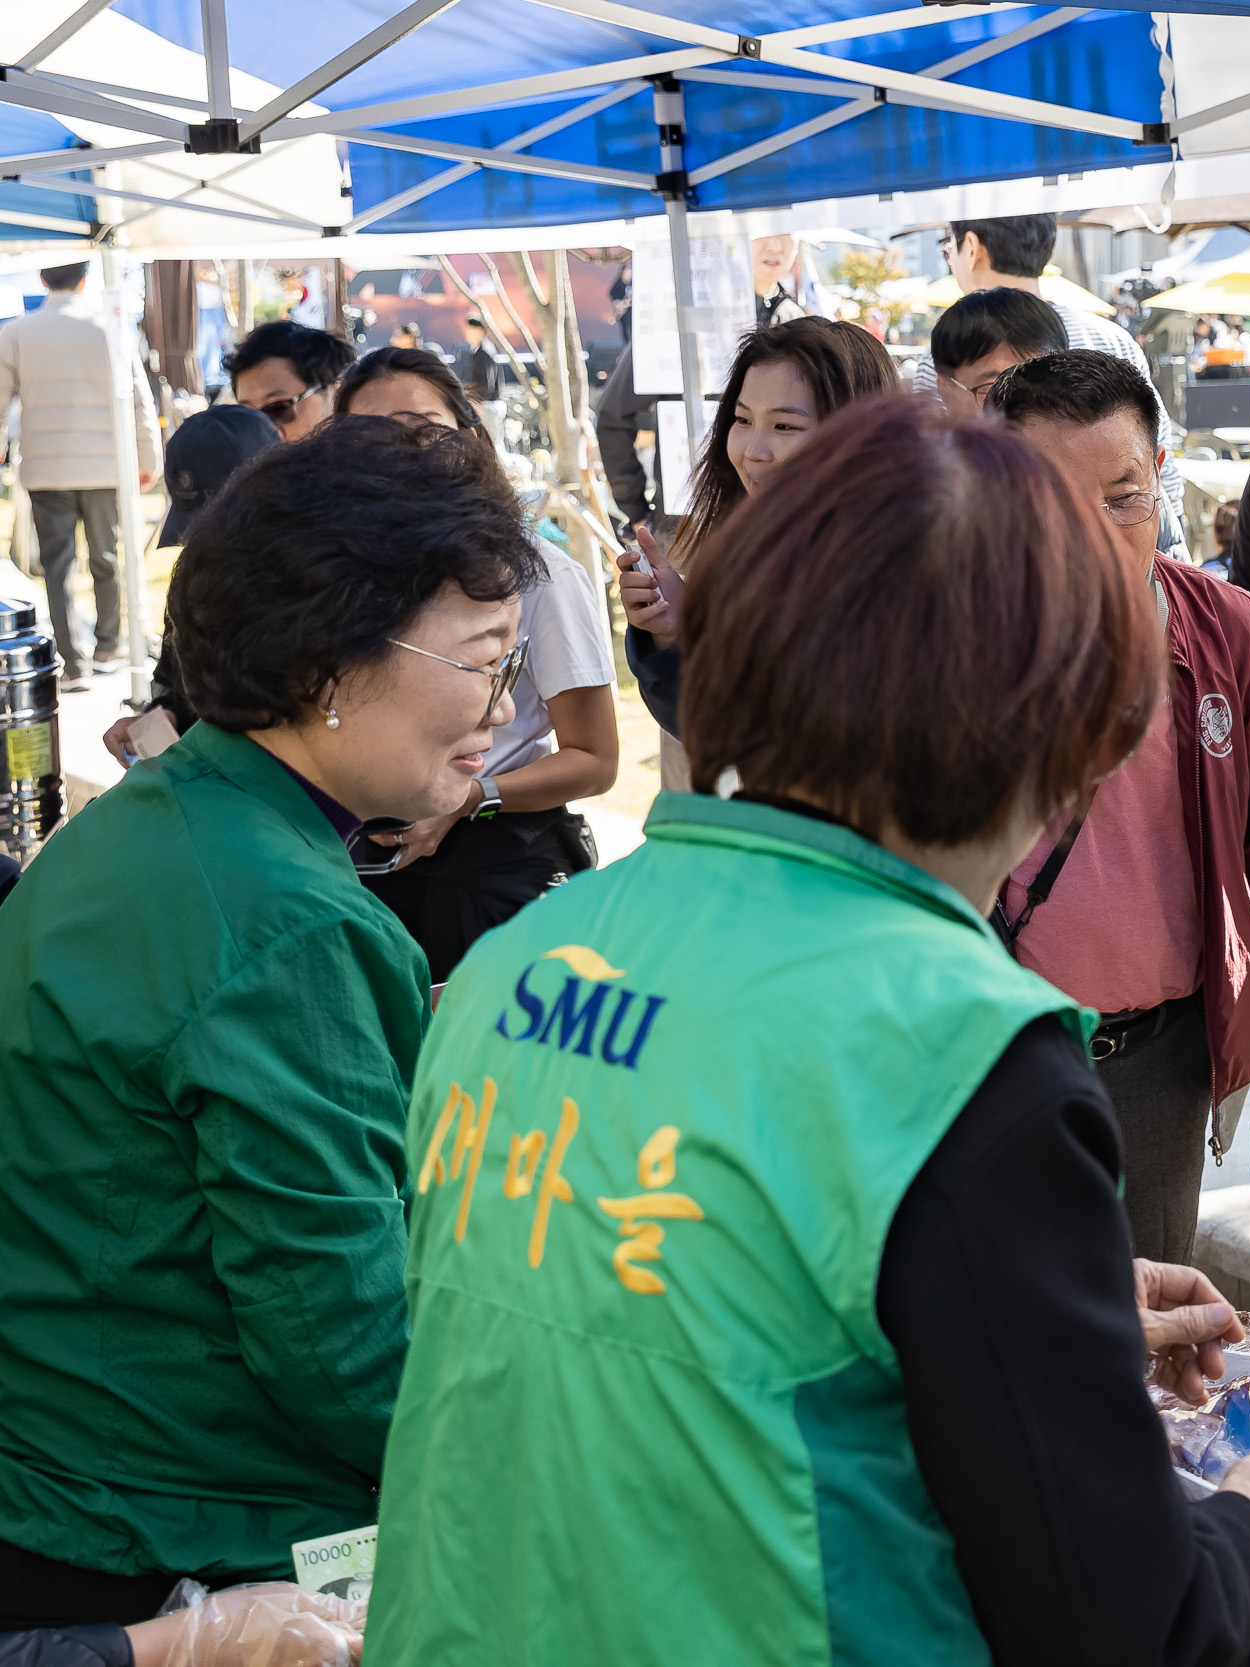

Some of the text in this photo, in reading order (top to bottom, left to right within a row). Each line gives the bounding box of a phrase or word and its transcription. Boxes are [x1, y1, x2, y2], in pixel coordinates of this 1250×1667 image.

[495, 962, 667, 1071] SMU
[418, 1076, 704, 1295] 새마을
[300, 1543, 351, 1566] 10000
